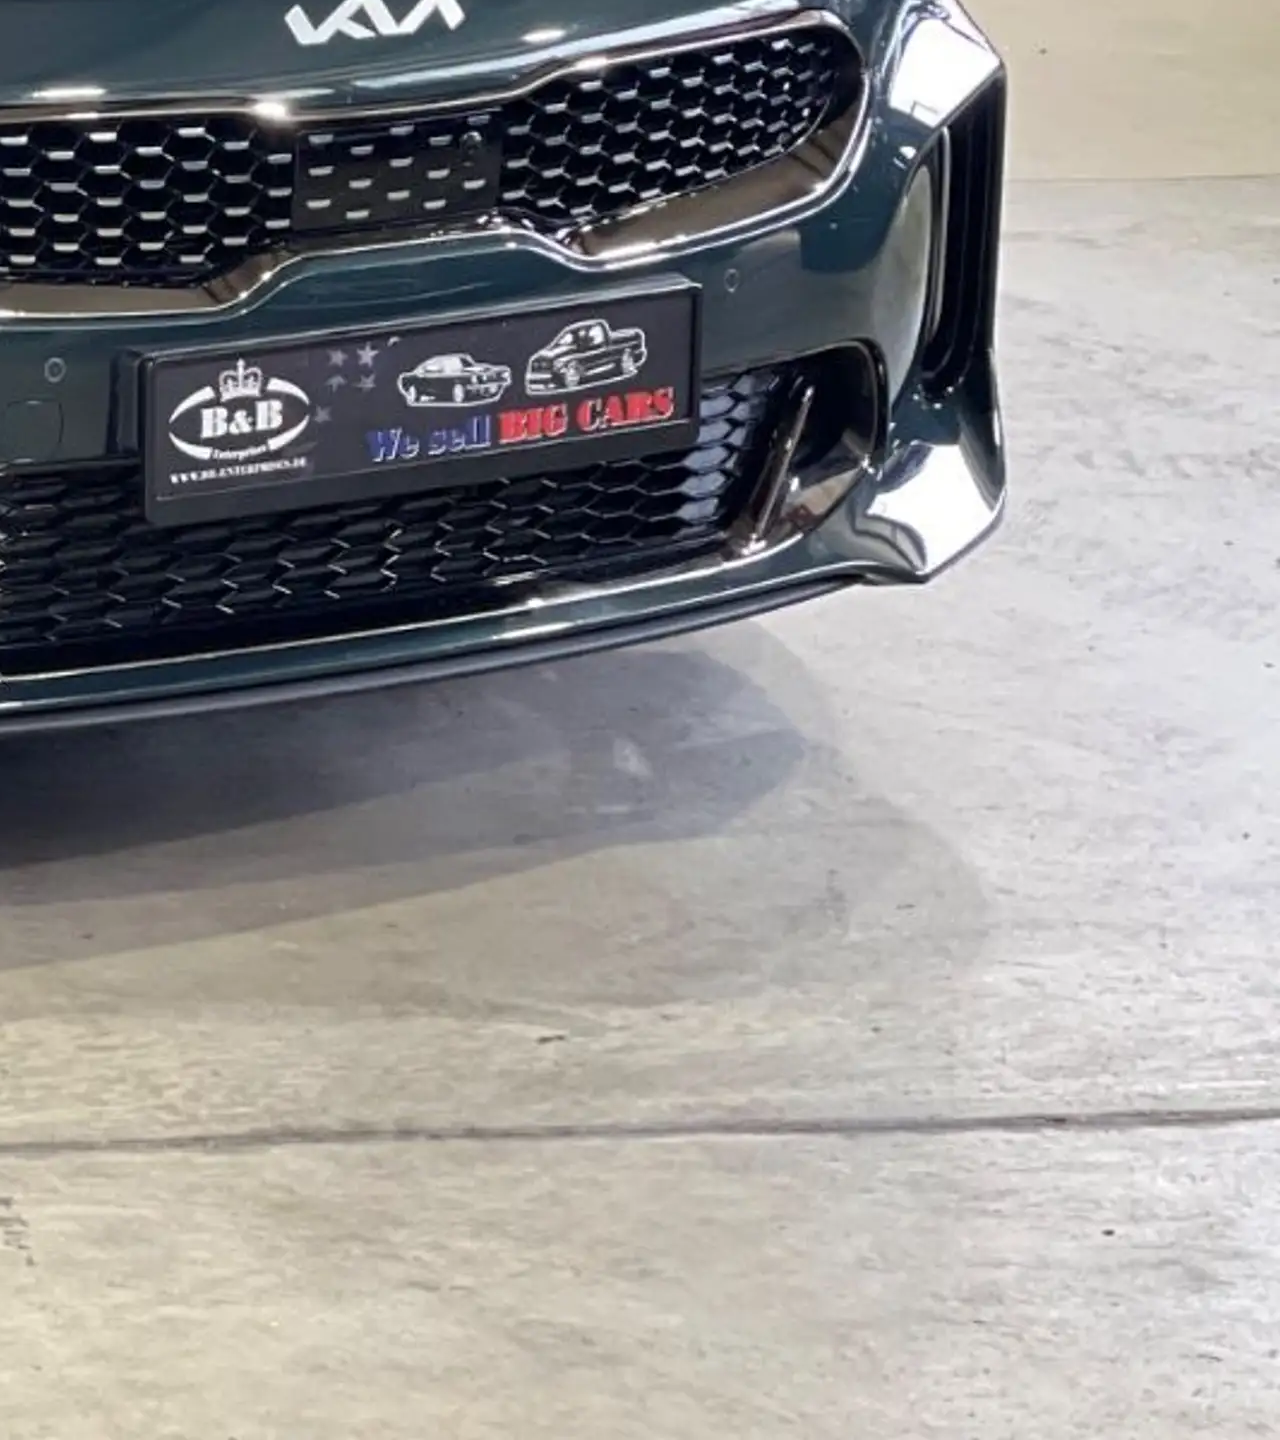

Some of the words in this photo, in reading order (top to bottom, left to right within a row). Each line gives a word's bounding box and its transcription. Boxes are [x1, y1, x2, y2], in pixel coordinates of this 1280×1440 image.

[201, 398, 283, 439] B&B
[365, 427, 420, 463] We
[498, 403, 569, 446] BIG
[574, 386, 675, 432] CARS
